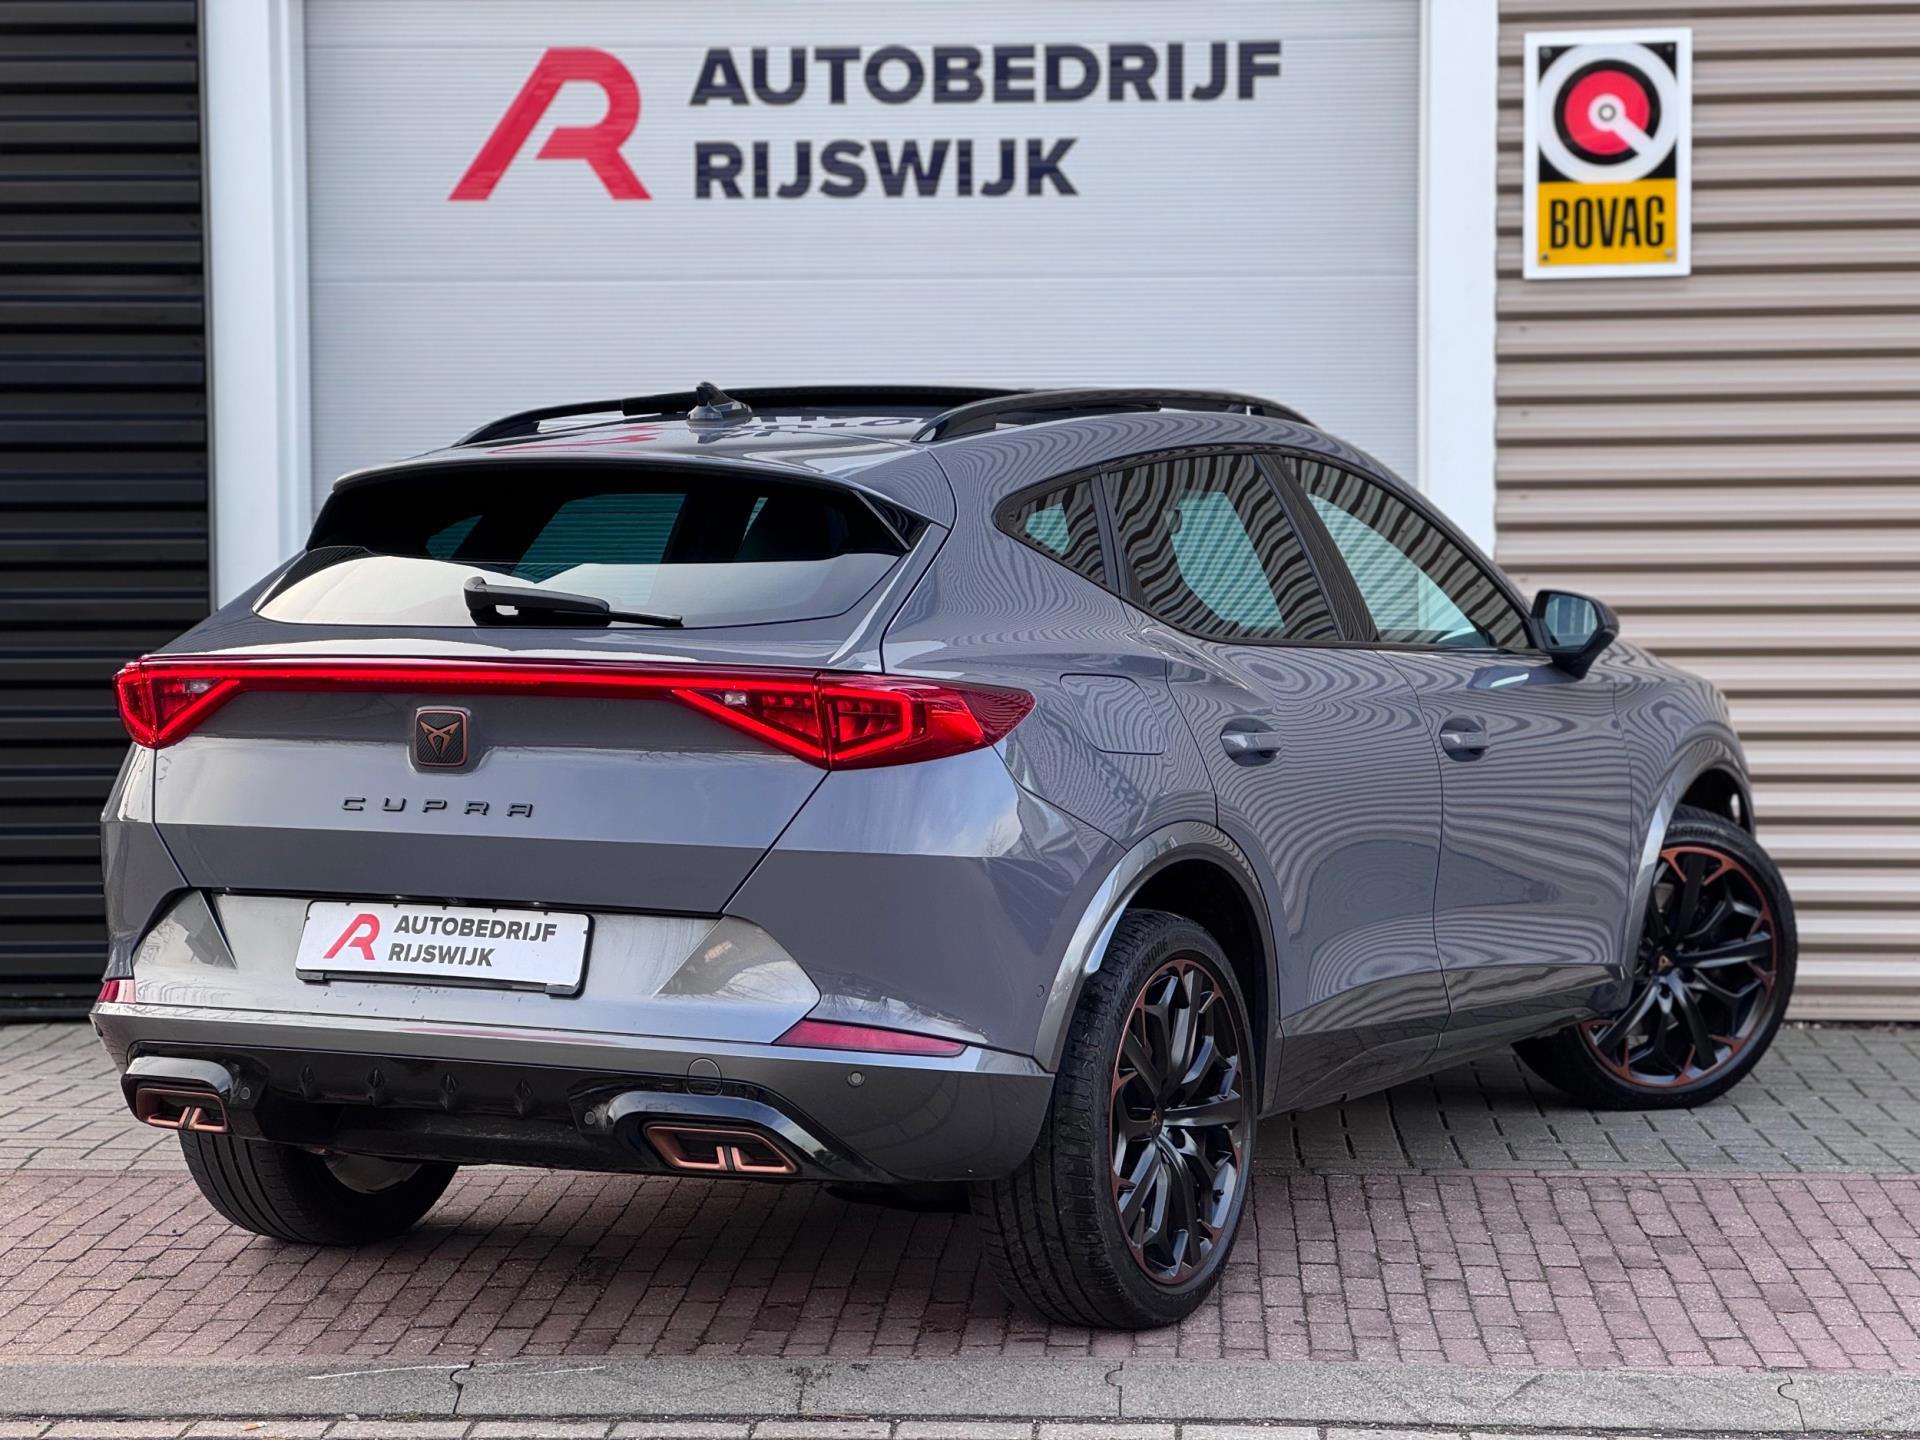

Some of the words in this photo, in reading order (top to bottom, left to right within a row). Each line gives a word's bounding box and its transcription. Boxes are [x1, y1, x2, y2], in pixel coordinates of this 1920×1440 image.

[689, 40, 1282, 106] AUTOBEDRIJF
[695, 137, 1079, 200] RIJSWIJK
[1550, 196, 1664, 249] BOVAG
[342, 797, 533, 818] CUPRA
[393, 914, 558, 942] AUTOBEDRIJF
[388, 942, 496, 967] RIJSWIJK
